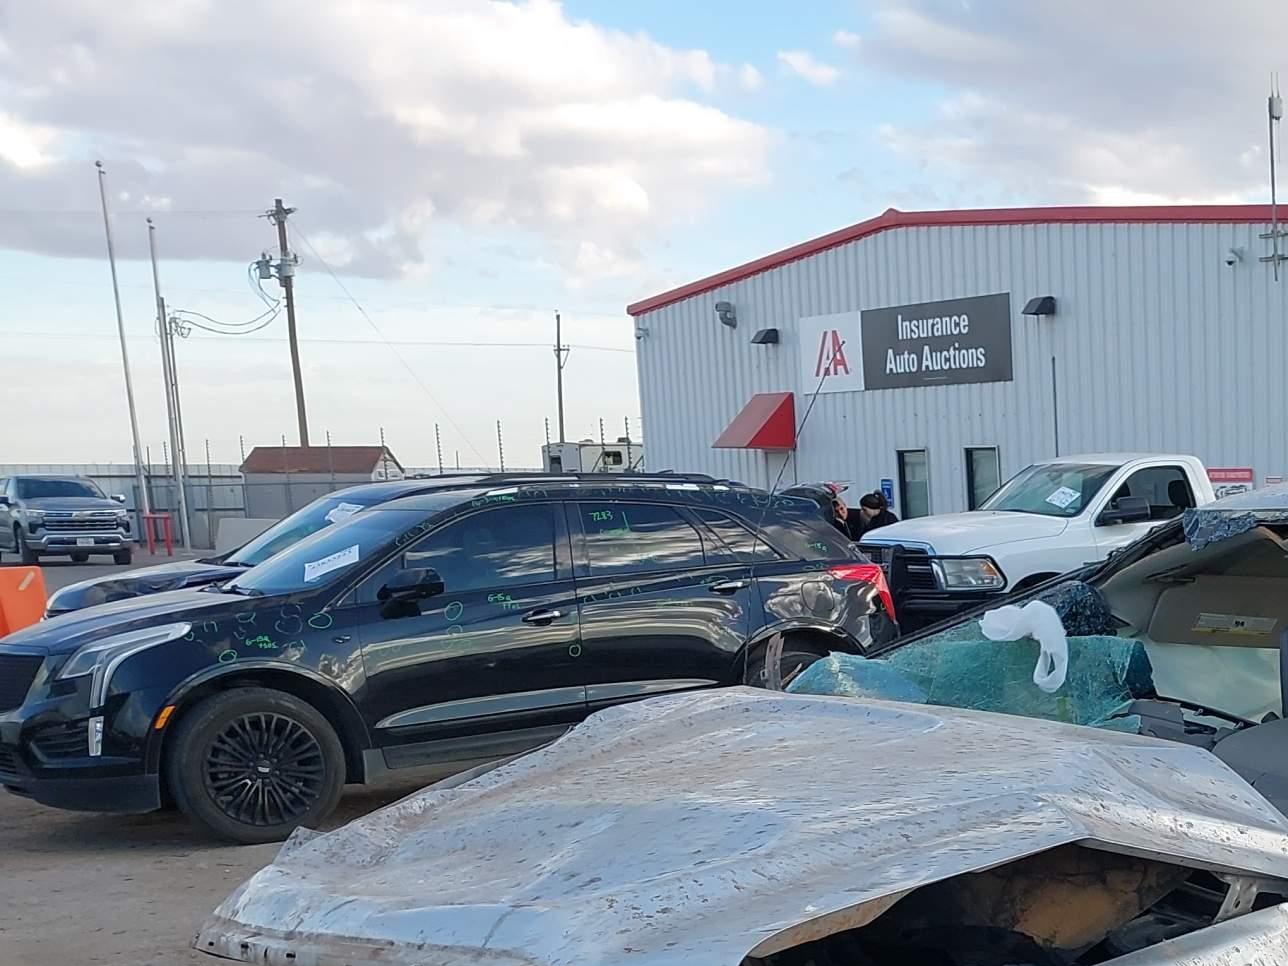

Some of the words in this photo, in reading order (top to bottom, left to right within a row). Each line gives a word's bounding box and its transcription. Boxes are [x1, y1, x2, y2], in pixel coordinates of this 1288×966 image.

[897, 314, 969, 340] Insurance
[886, 348, 918, 374] Auto
[922, 342, 986, 372] Auctions
